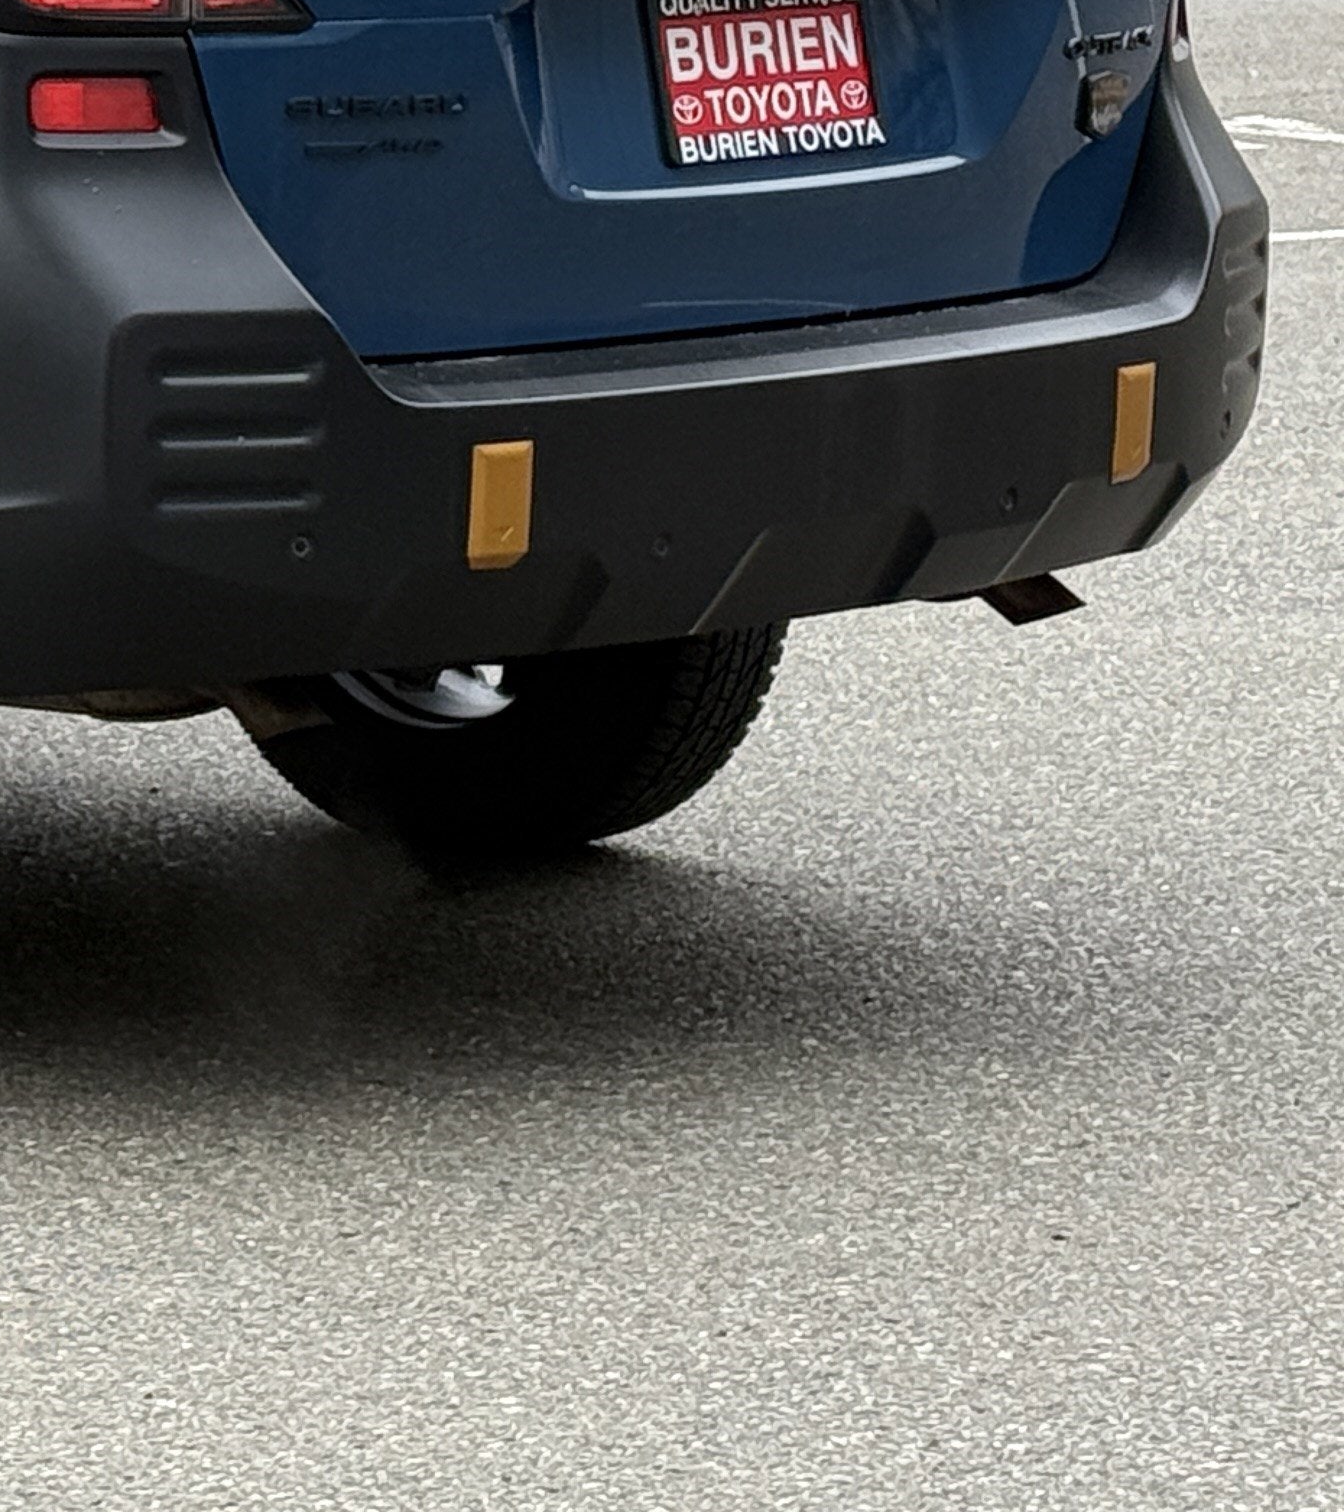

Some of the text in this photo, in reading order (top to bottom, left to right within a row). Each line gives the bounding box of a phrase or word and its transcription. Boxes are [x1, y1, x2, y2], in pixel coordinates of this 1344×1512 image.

[665, 13, 860, 83] BURIEN
[284, 94, 466, 118] SUBARU
[703, 79, 840, 126] TOYOTA
[679, 118, 887, 164] BURIEN TOYOTA
